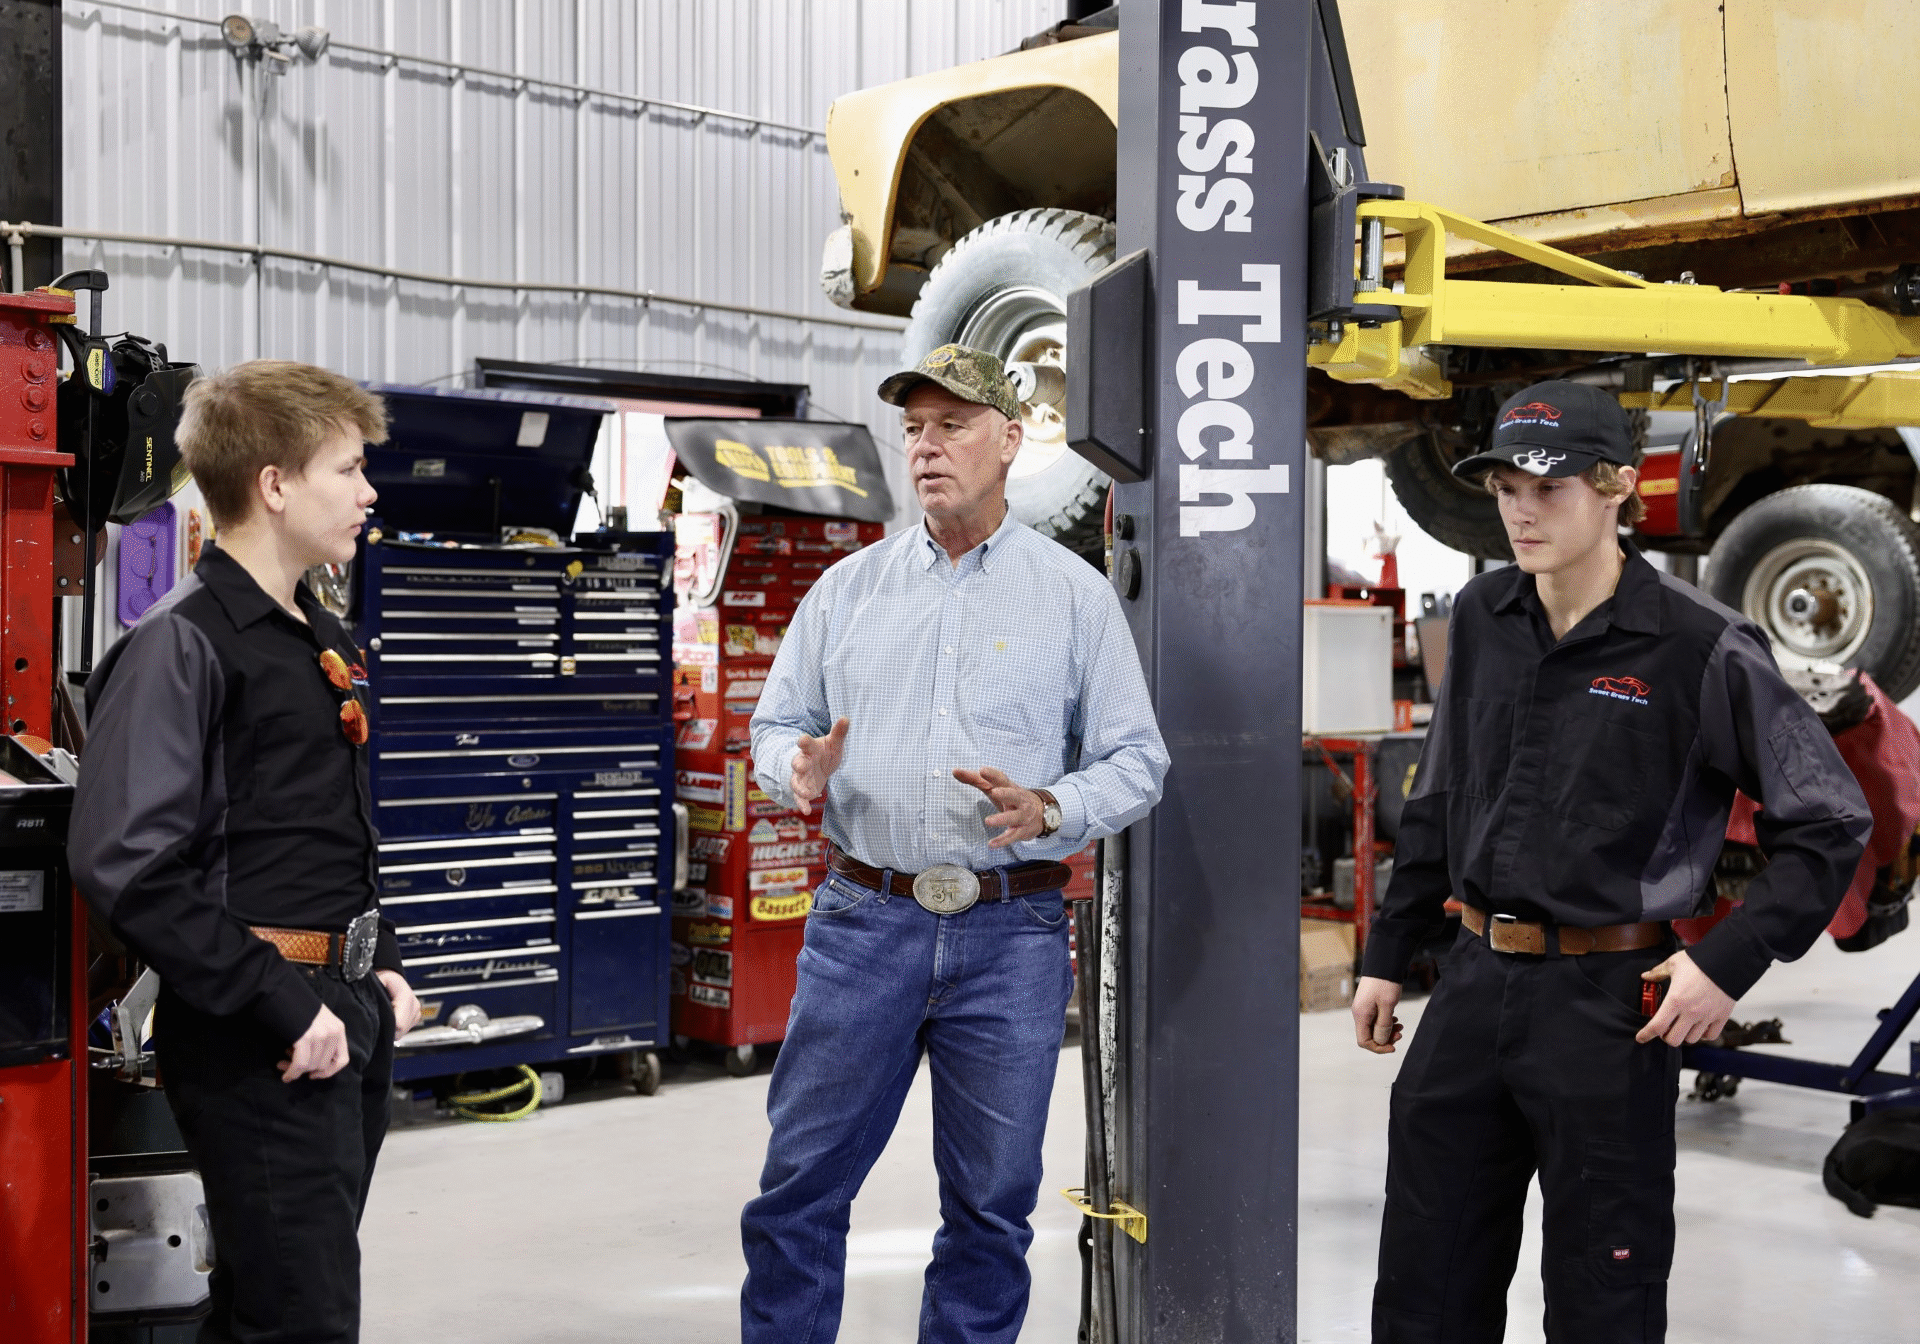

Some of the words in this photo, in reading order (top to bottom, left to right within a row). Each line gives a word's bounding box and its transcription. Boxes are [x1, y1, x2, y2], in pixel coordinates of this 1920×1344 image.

[1177, 0, 1259, 232] rass
[1175, 263, 1290, 537] Tech
[1540, 418, 1560, 428] Tech
[1631, 694, 1649, 706] Tech
[751, 840, 823, 861] HUGHES
[757, 896, 807, 916] Bassett
